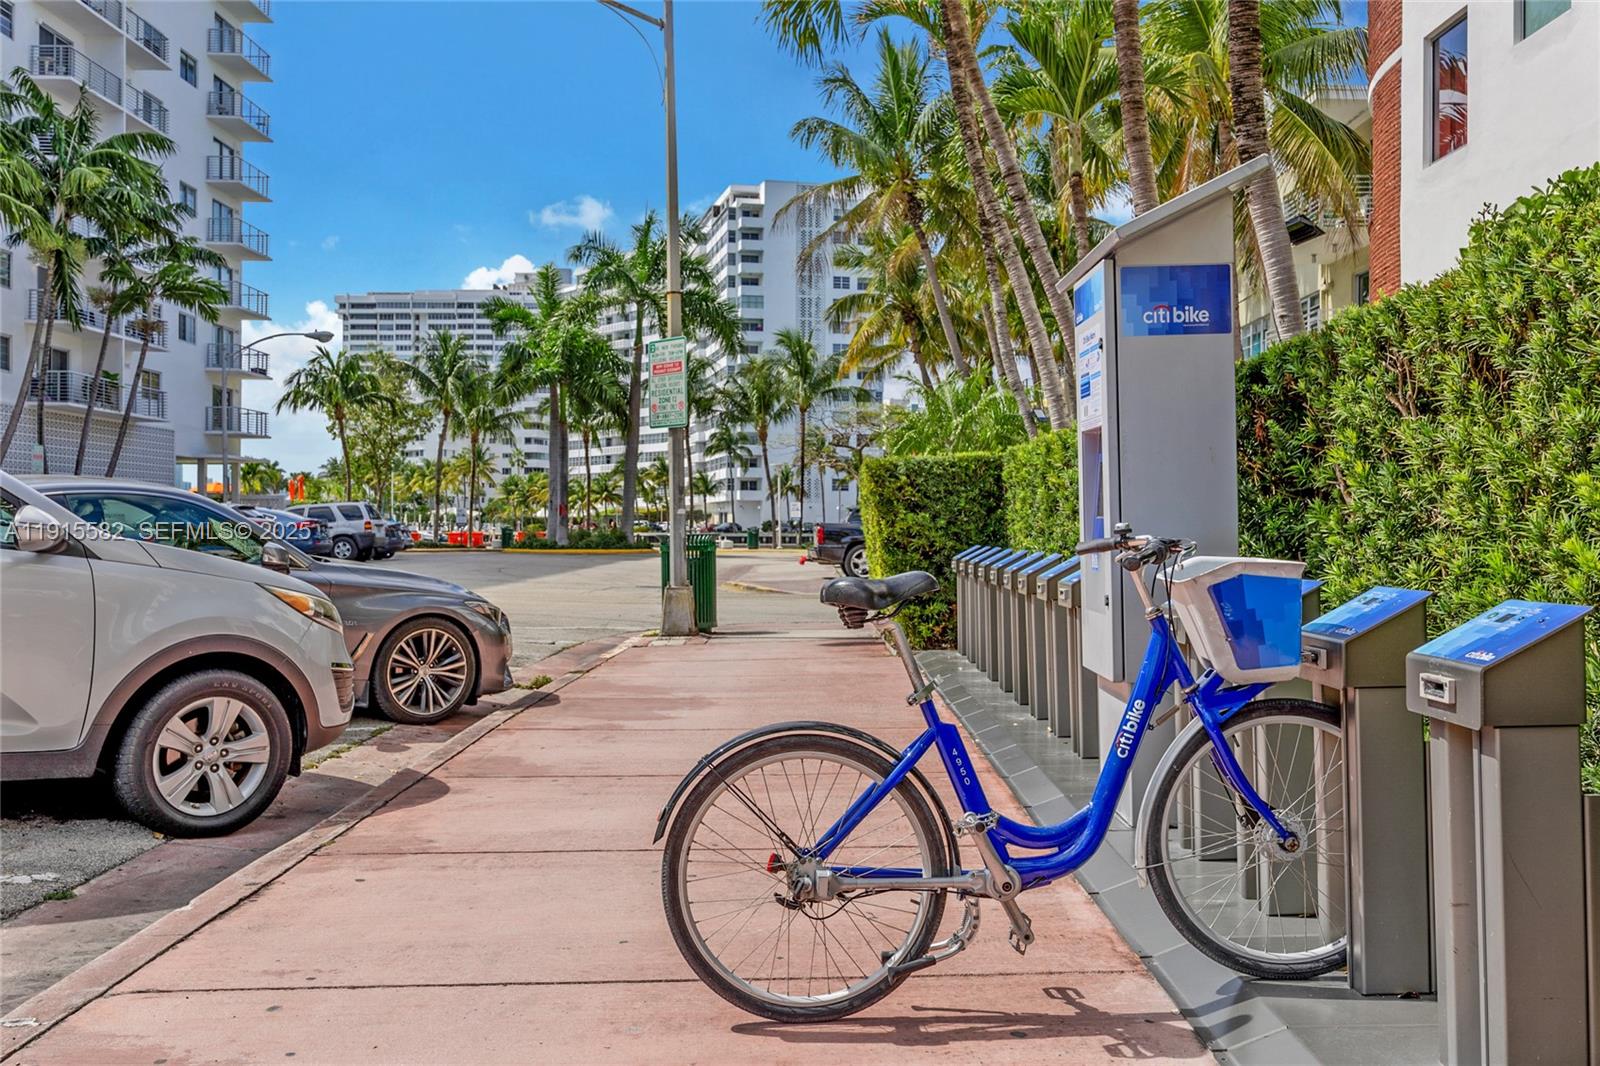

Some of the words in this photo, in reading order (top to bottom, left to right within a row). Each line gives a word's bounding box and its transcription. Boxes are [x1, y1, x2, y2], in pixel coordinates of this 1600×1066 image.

[1143, 306, 1170, 324] citi
[1173, 305, 1210, 323] bike
[1123, 699, 1146, 732] bike
[1116, 732, 1135, 759] citi
[952, 747, 971, 786] 4950
